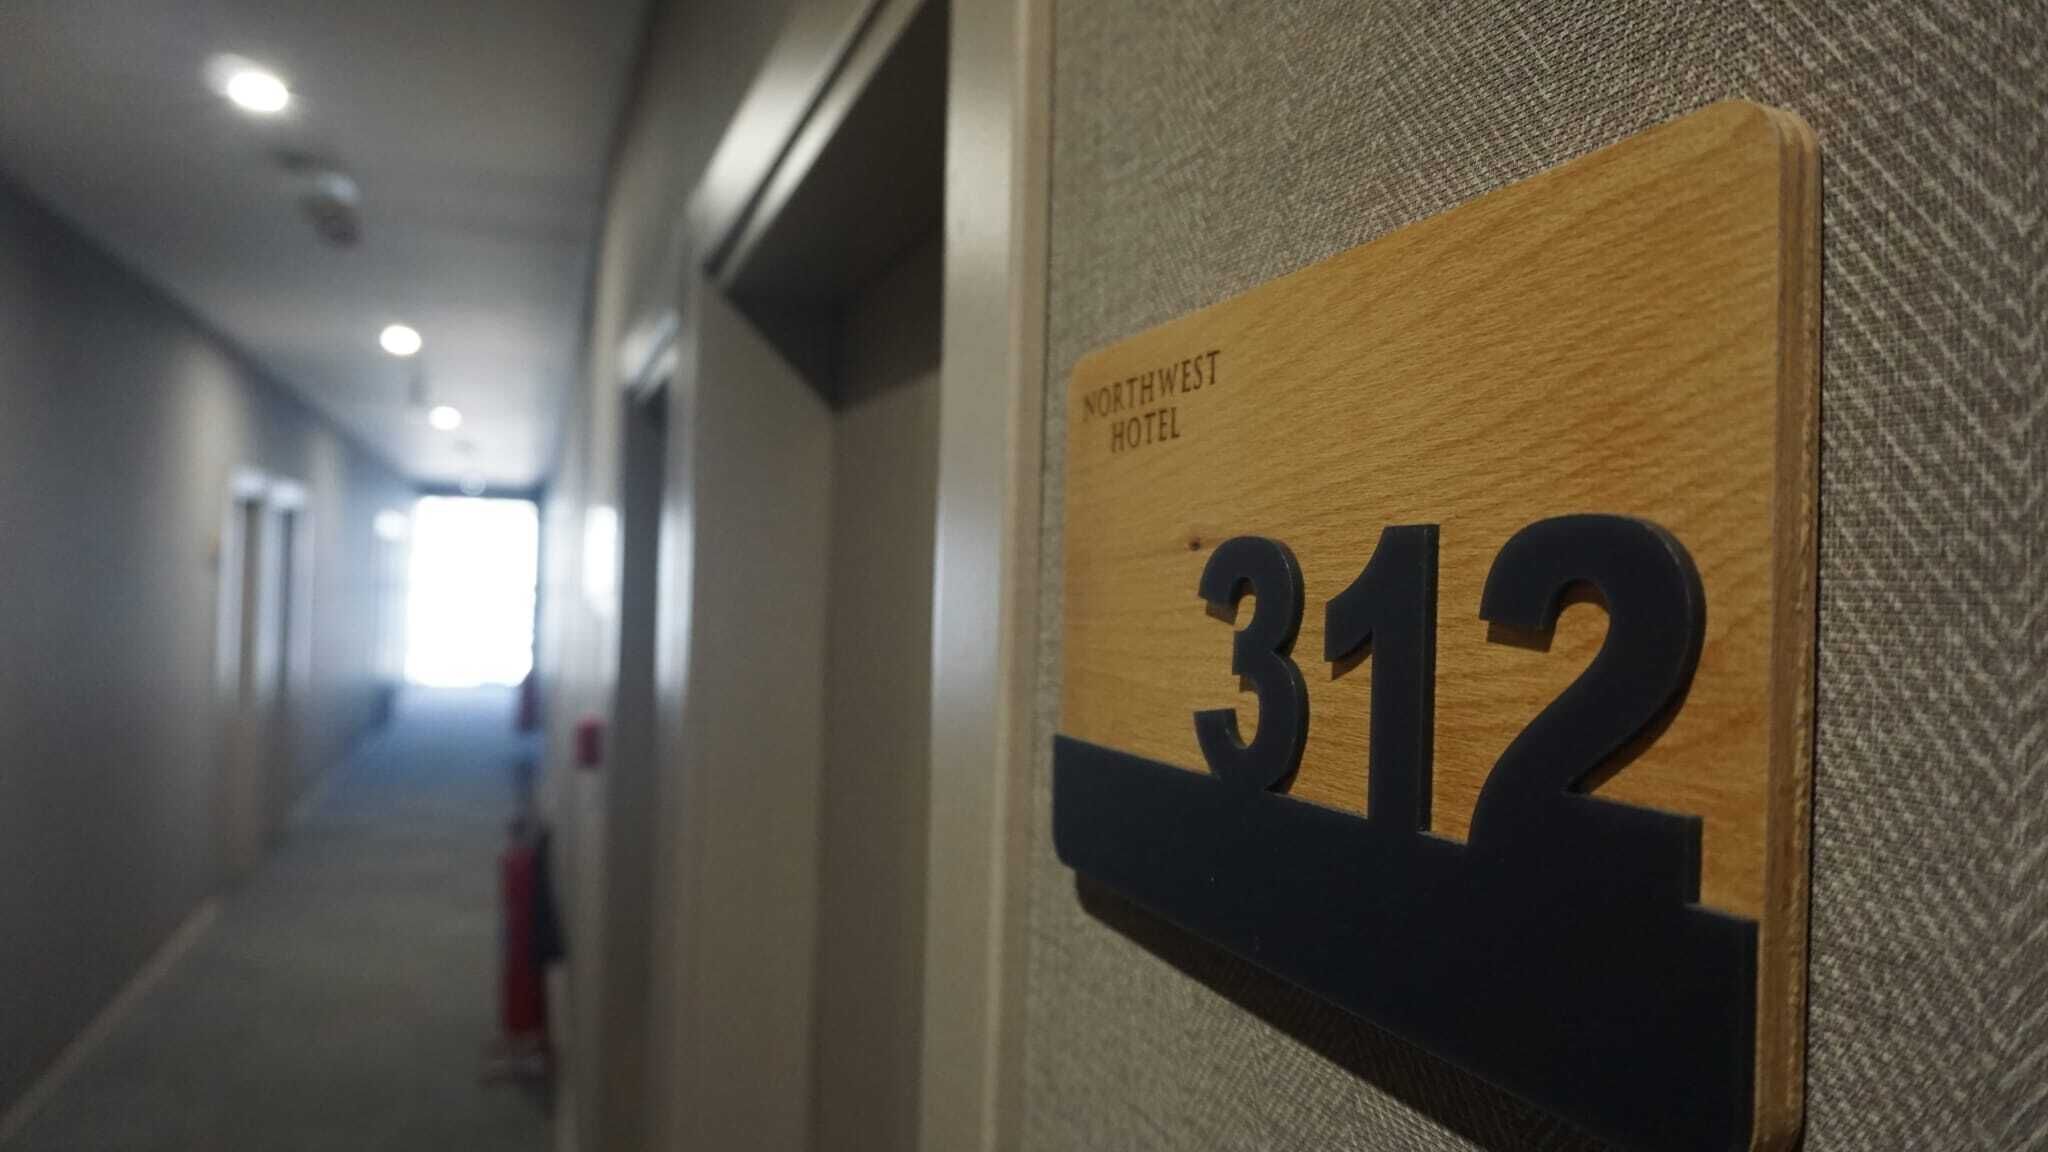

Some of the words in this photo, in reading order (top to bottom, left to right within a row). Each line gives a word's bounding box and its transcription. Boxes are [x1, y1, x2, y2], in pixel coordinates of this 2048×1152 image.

[1082, 350, 1221, 422] NORTHWEST
[1111, 407, 1181, 453] HOTEL
[1193, 513, 1706, 900] 312
